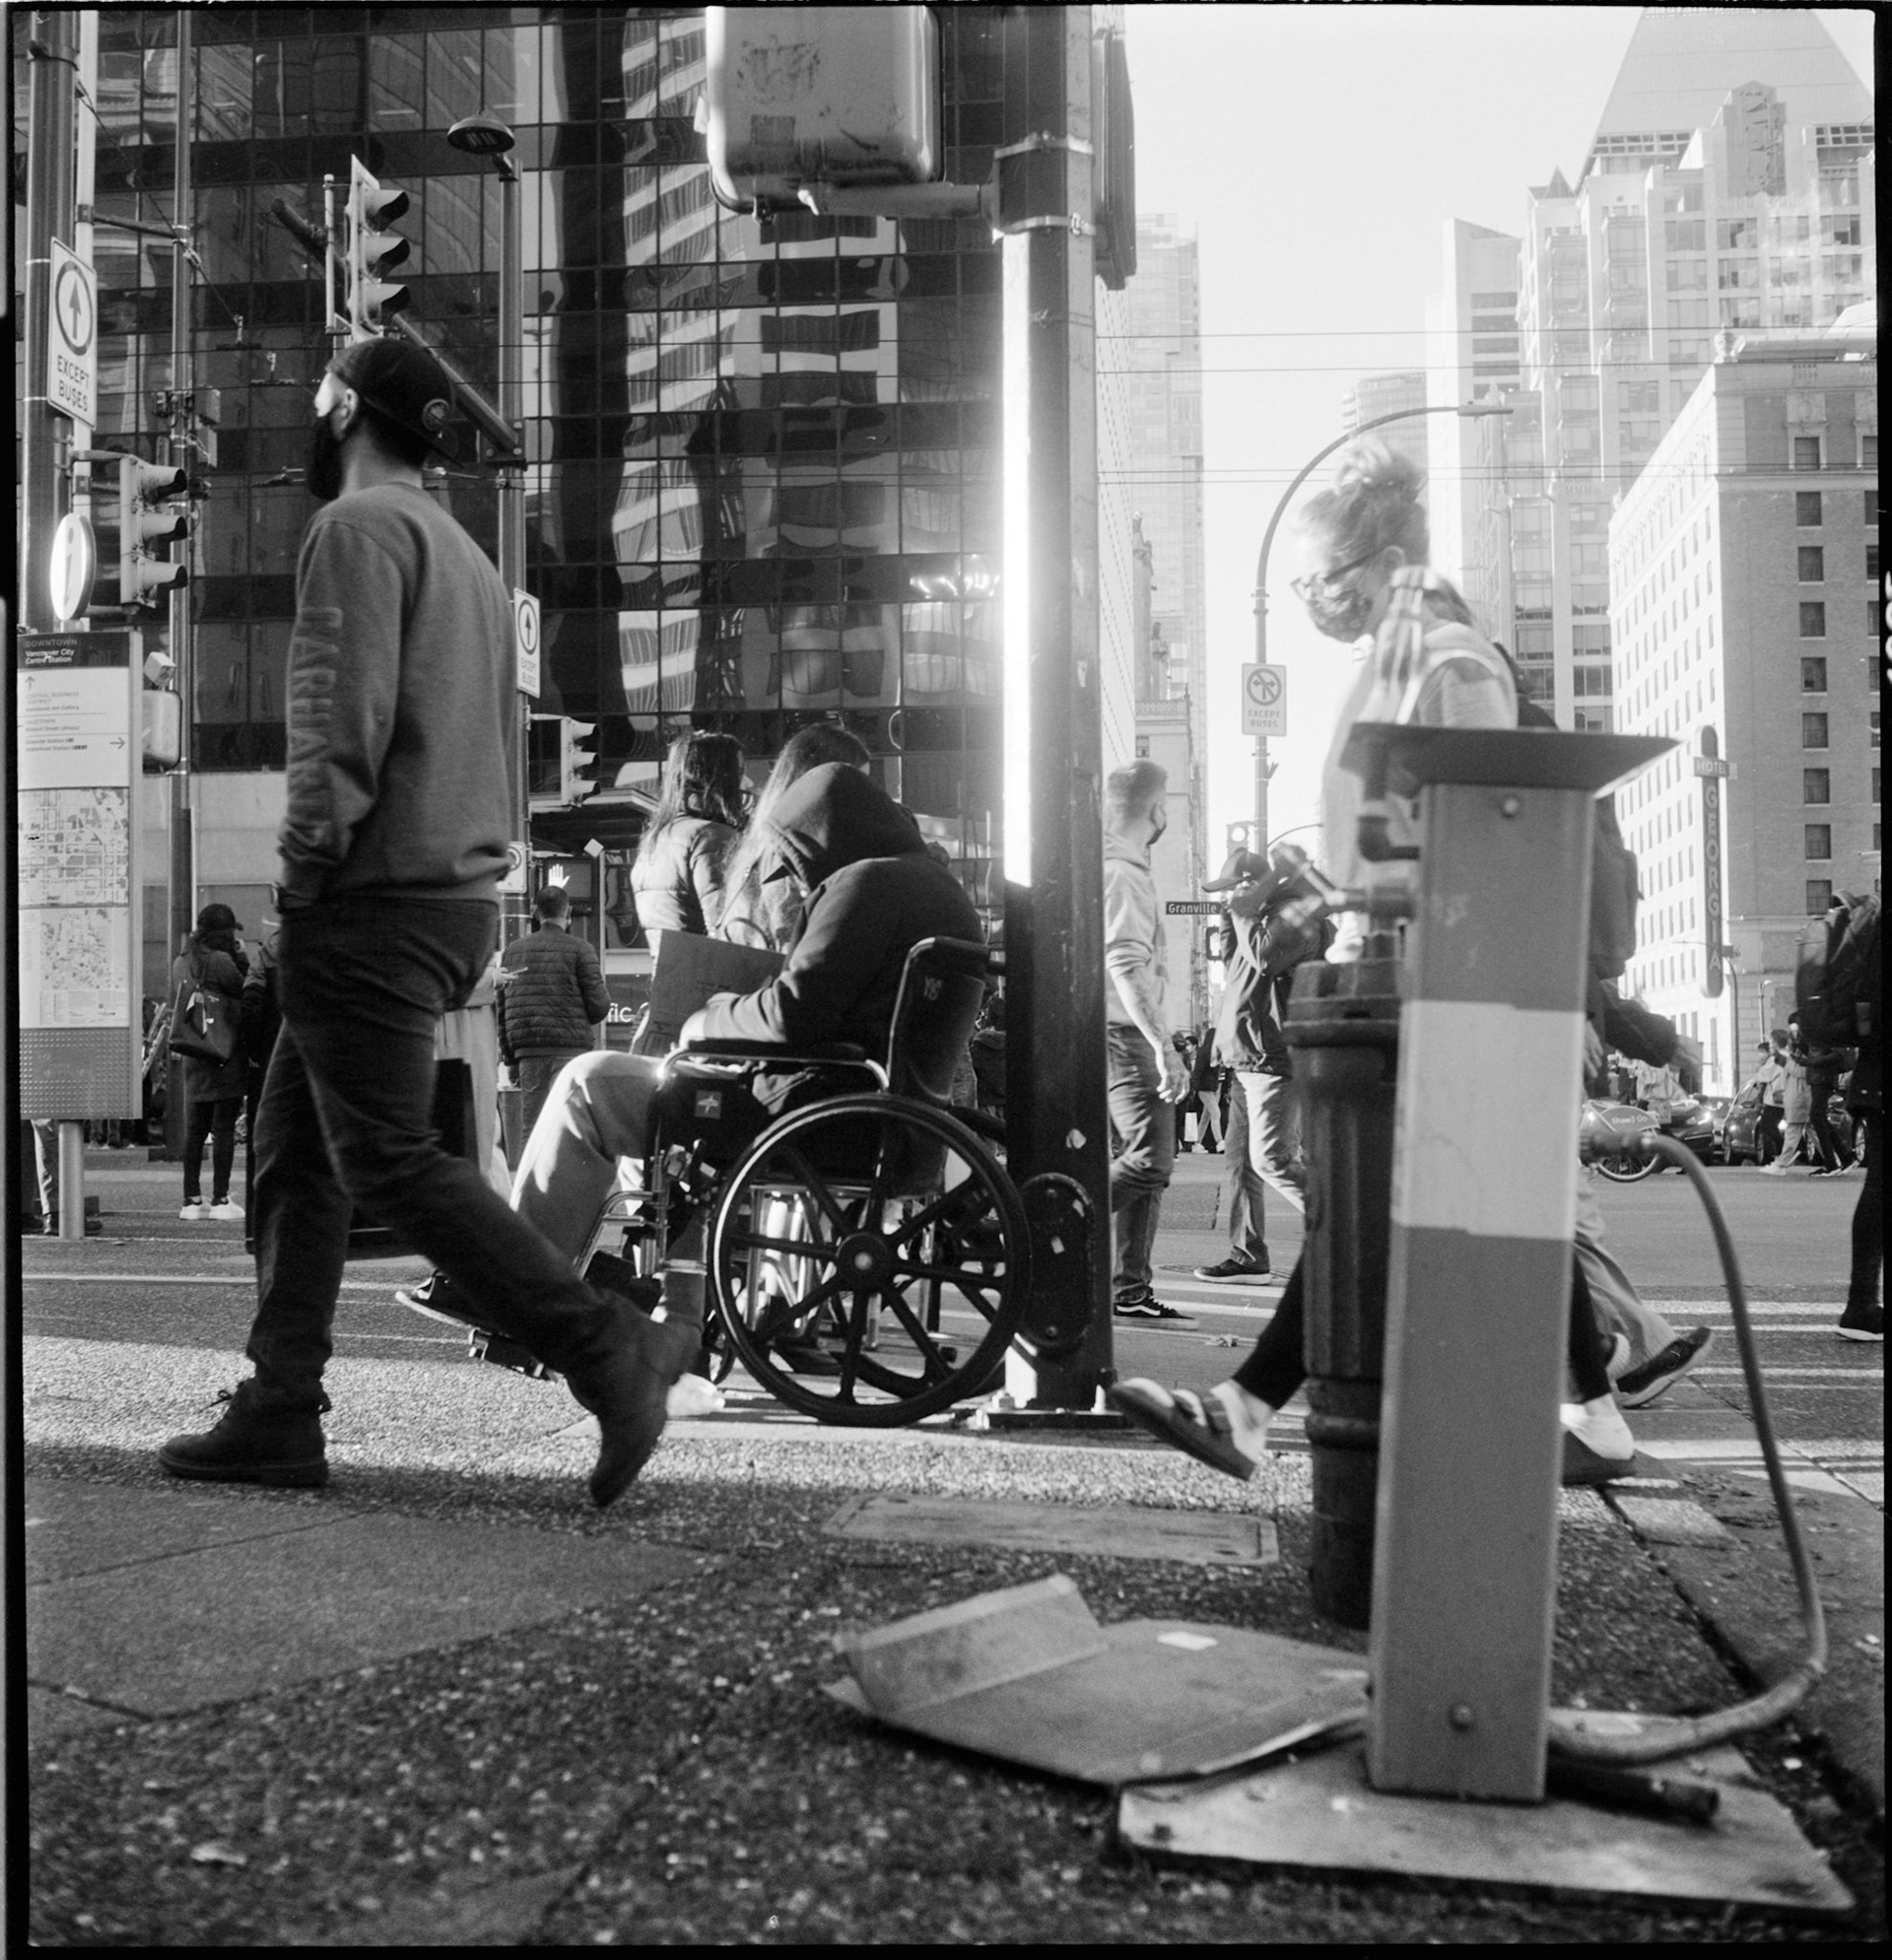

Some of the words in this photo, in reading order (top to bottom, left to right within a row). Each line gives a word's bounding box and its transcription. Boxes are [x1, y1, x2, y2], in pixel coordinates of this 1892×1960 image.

[57, 355, 90, 390] EXCEPT
[59, 380, 89, 412] BUSES
[25, 639, 78, 647] DOWNTOWN
[60, 647, 75, 656] City
[1248, 710, 1280, 718] EXCEPT
[1697, 760, 1726, 775] HOTEL
[1705, 784, 1721, 972] GEORGIA
[1168, 903, 1217, 913] Granville
